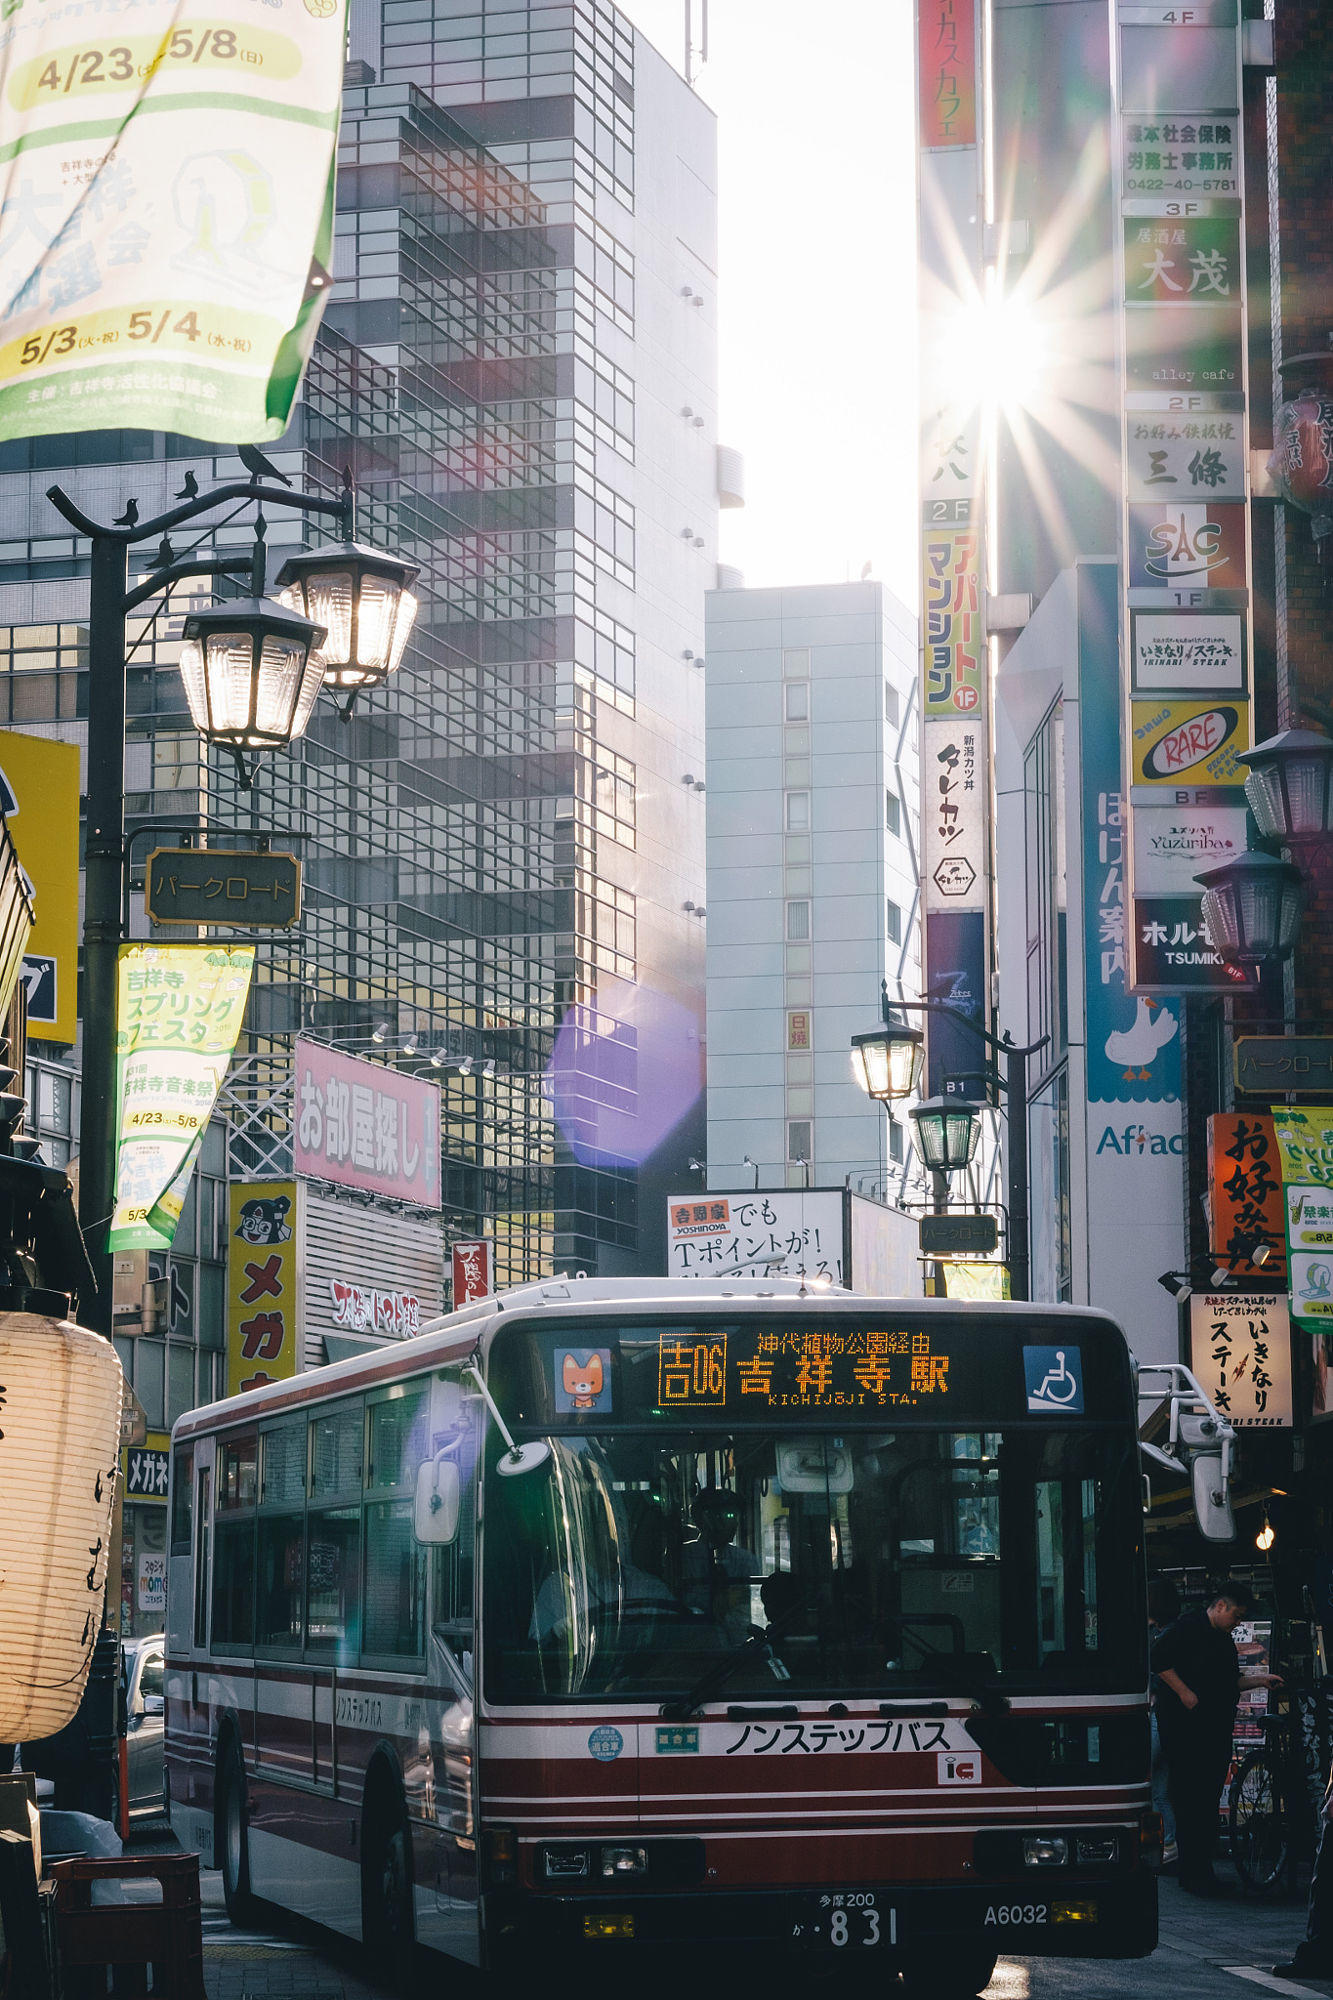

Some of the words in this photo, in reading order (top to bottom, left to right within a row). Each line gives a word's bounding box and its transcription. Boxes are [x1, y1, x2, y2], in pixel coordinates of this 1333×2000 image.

[1162, 11, 1194, 24] 4F
[1126, 124, 1232, 145] 森本社会保険
[1127, 152, 1233, 171] 労務士事務所
[1127, 178, 1236, 191] 0422-40-5781
[1165, 203, 1198, 215] 3F
[1136, 228, 1187, 246] 居酒屋
[1138, 250, 1230, 295] 大茂
[1152, 368, 1195, 383] alley
[1202, 368, 1234, 381] cafe
[1169, 397, 1201, 409] 2F
[1143, 449, 1229, 487] 三條
[932, 502, 968, 521] 2F
[954, 534, 977, 682] アパート
[1175, 593, 1202, 606] 1F
[928, 543, 952, 704] マンション
[1140, 644, 1184, 658] いきなり
[1194, 645, 1233, 657] ステーキ
[957, 690, 975, 708] 1F
[1163, 713, 1219, 768] RARE
[963, 735, 975, 792] 新潟カツ丼
[936, 743, 965, 847] タレカツ
[1175, 791, 1207, 804] BF
[155, 876, 291, 900] パークロード
[127, 969, 184, 990] 吉祥寺
[126, 992, 237, 1022] スプリング
[127, 1021, 207, 1045] フェスタ
[946, 1081, 965, 1093] B1
[299, 1070, 421, 1178] お部屋探し
[675, 1203, 726, 1224] 吉野家
[733, 1199, 777, 1227] でも
[676, 1223, 727, 1235] YOSHINOYA
[757, 1331, 931, 1354] 神代植物公園経由
[736, 1354, 950, 1394] 吉祥寺駅
[1210, 1321, 1233, 1412] ステーキ
[1248, 1319, 1273, 1413] いきなり
[878, 1393, 918, 1405] STA.
[1247, 1418, 1284, 1426] STEAK
[726, 1720, 951, 1754] ノンステップバス
[984, 1904, 1047, 1926] A6032
